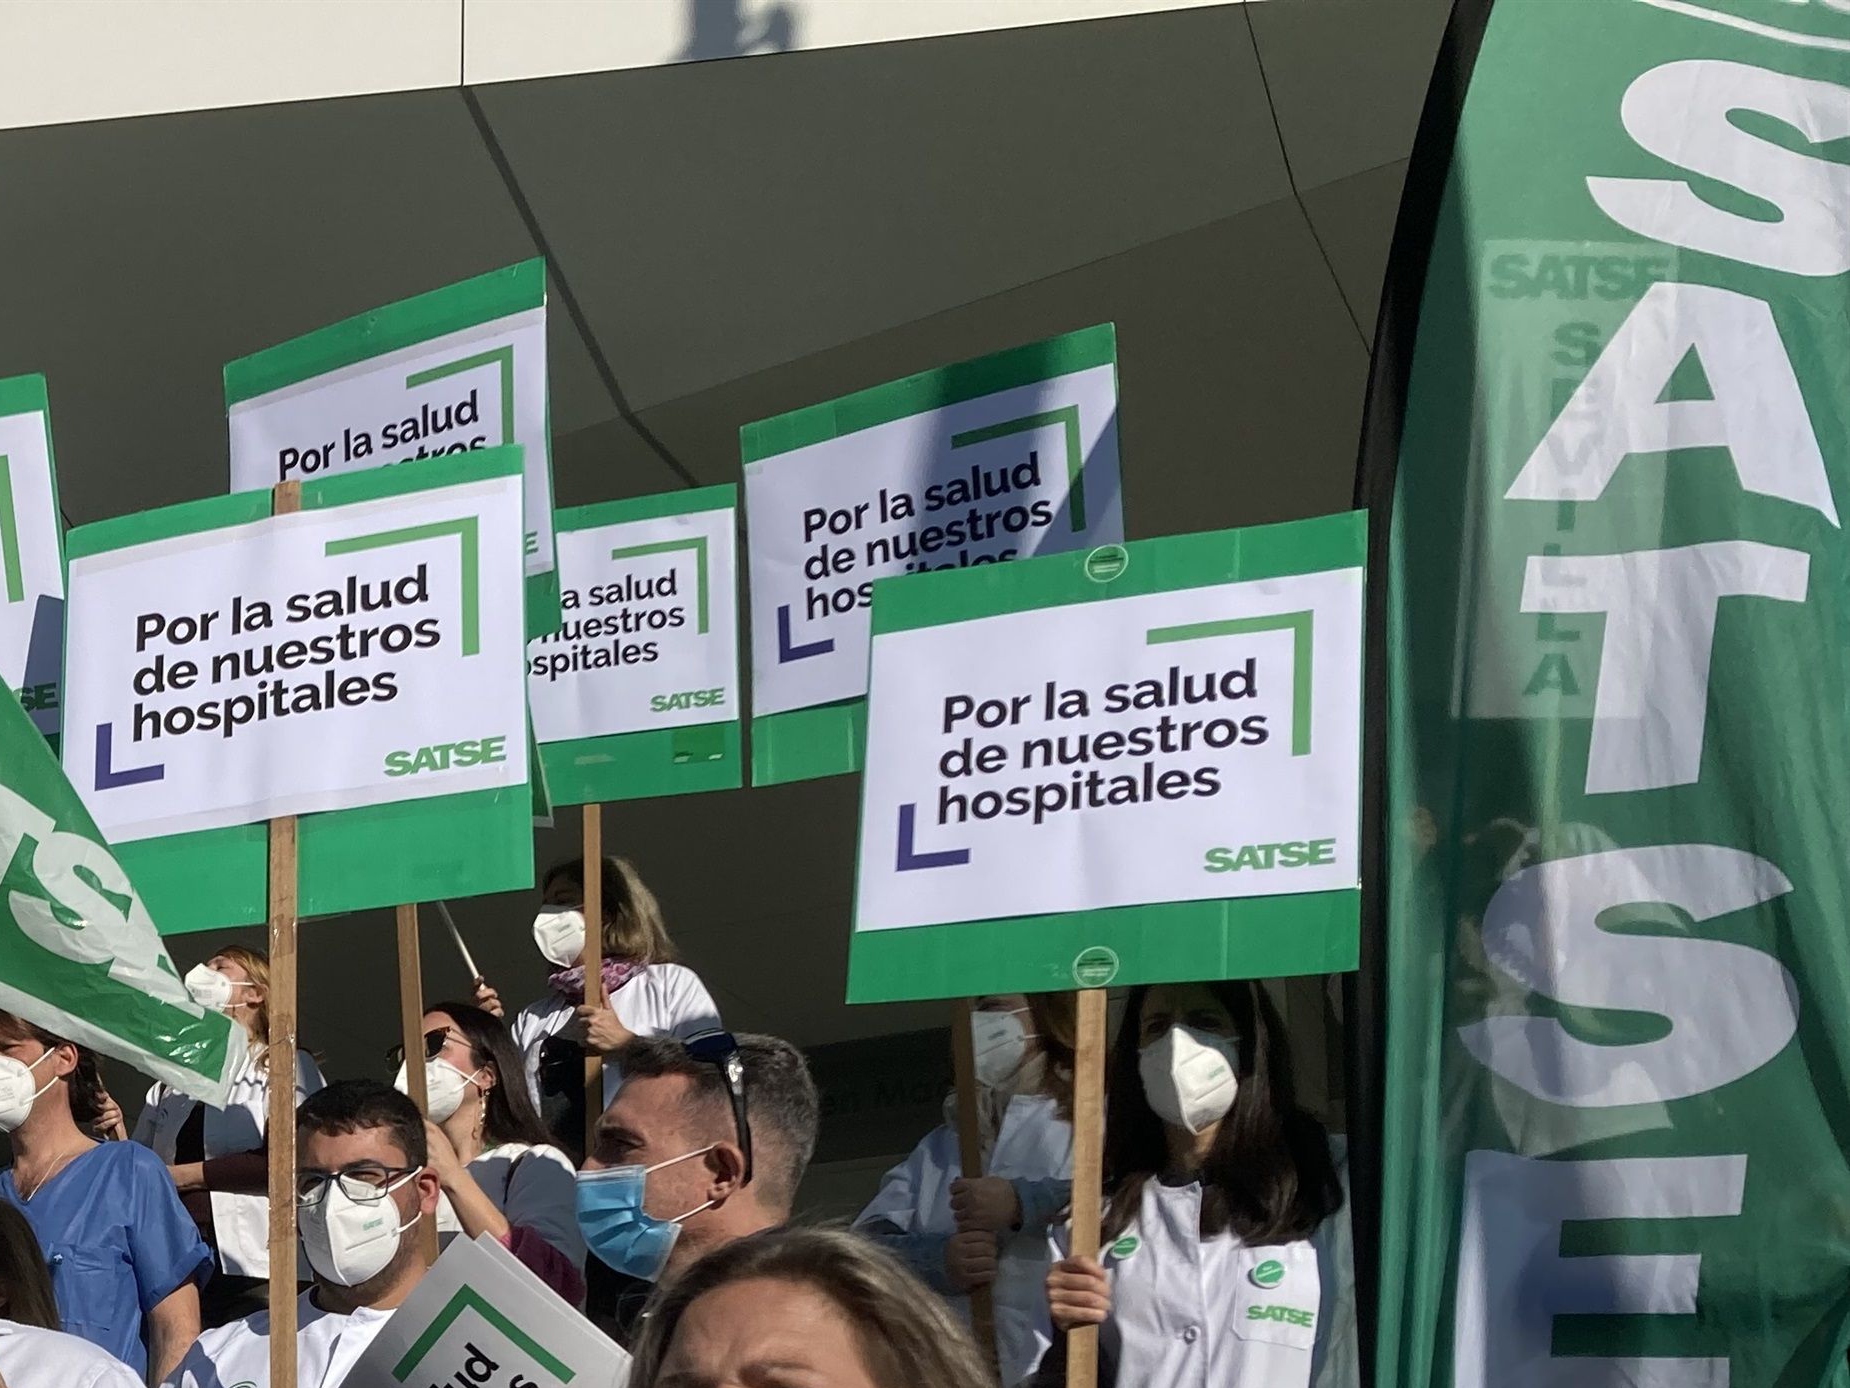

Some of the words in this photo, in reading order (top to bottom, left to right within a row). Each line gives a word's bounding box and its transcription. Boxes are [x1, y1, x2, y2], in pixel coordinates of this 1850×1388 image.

[277, 437, 337, 483] Por
[343, 427, 373, 464] la
[380, 388, 480, 451] salud
[804, 501, 870, 543] Por
[878, 488, 916, 524] la
[923, 450, 1043, 513] salud
[804, 543, 857, 582] de
[866, 498, 1054, 567] nuestros
[135, 607, 220, 653] Por
[230, 594, 273, 637] la
[285, 562, 430, 623] salud
[588, 567, 678, 607] salud
[132, 652, 199, 698] de
[211, 614, 442, 685] nuestros
[527, 638, 660, 683] spitales
[132, 669, 400, 744] hospitales
[649, 686, 726, 713] SATSE
[941, 693, 1033, 736] Por
[1045, 681, 1090, 723] la
[1103, 656, 1259, 714] salud
[383, 734, 508, 779] SATSE
[938, 737, 1009, 779] de
[1021, 711, 1271, 770] nuestros
[936, 761, 1223, 826] hospitales
[1203, 836, 1338, 875] SATSE
[1245, 1304, 1316, 1329] SATSE
